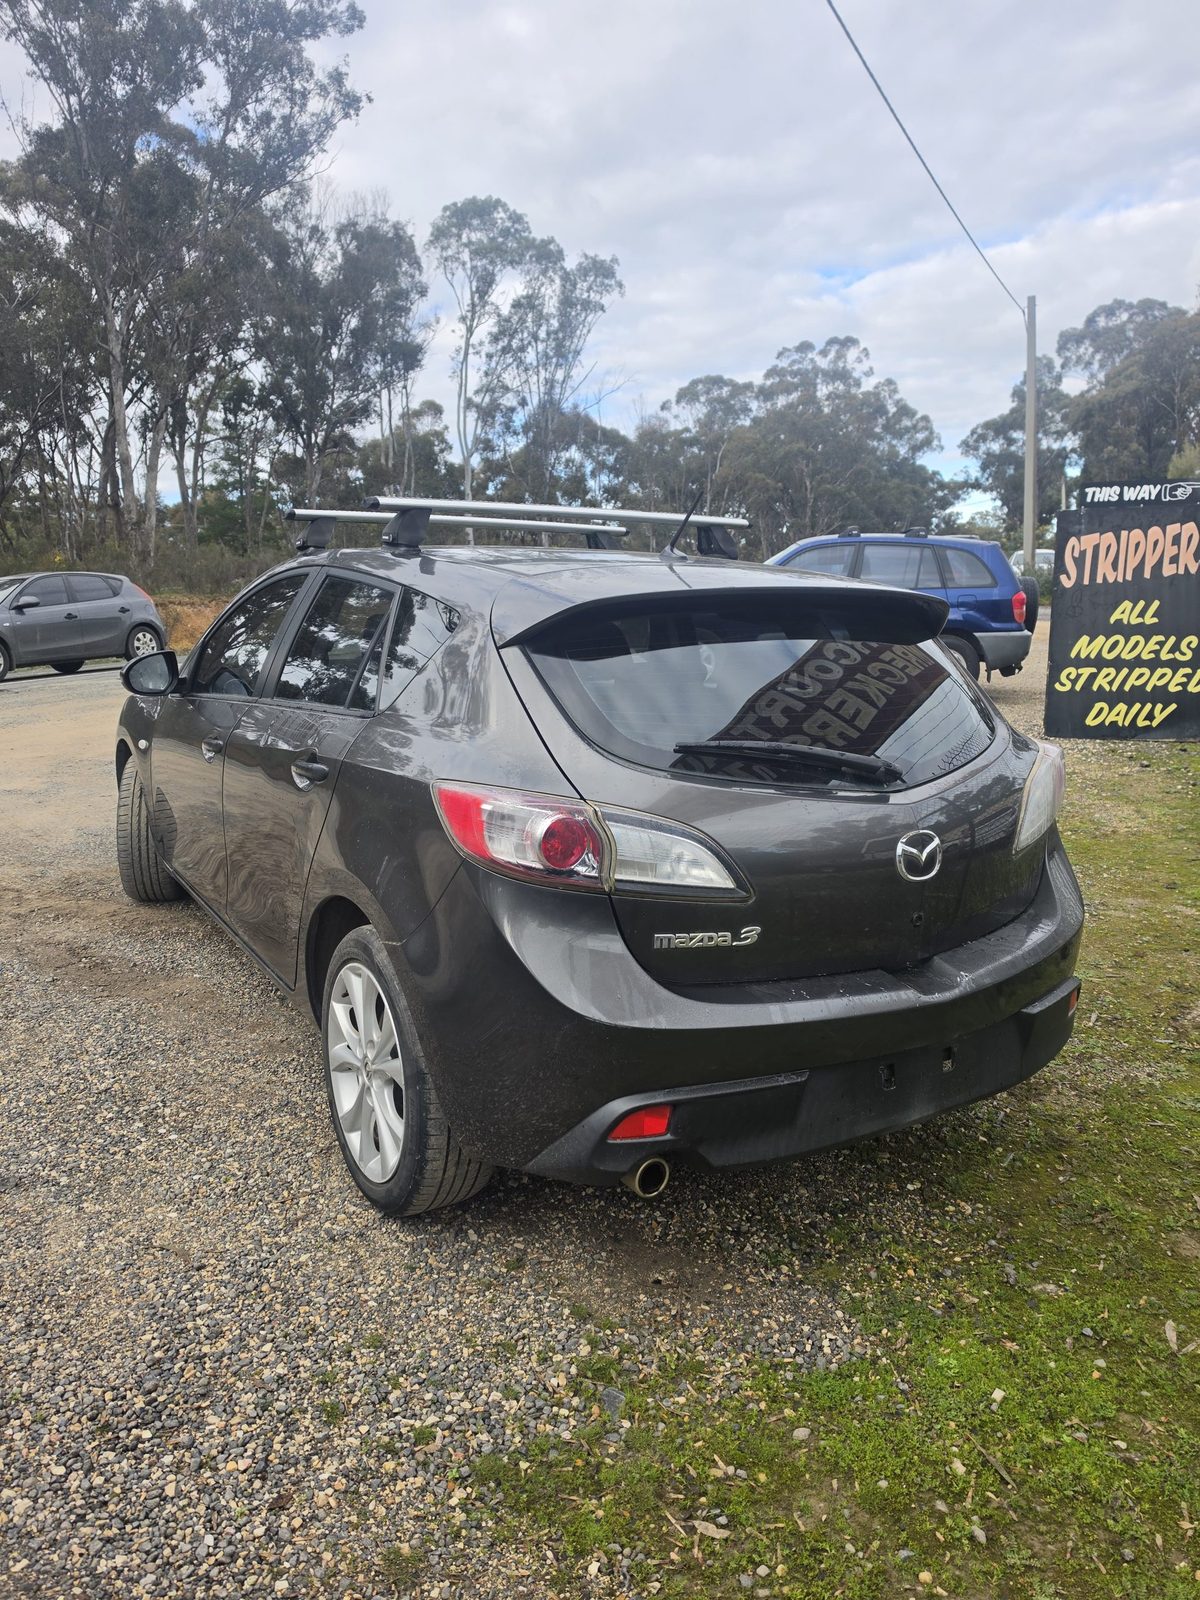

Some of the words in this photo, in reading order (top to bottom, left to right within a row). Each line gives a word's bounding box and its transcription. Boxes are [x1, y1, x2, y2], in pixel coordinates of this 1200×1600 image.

[1085, 485, 1121, 502] THIS
[1123, 483, 1161, 502] WAY
[1110, 600, 1160, 625] ALL
[1070, 635, 1199, 661] MODELS
[1085, 702, 1177, 727] DAILY
